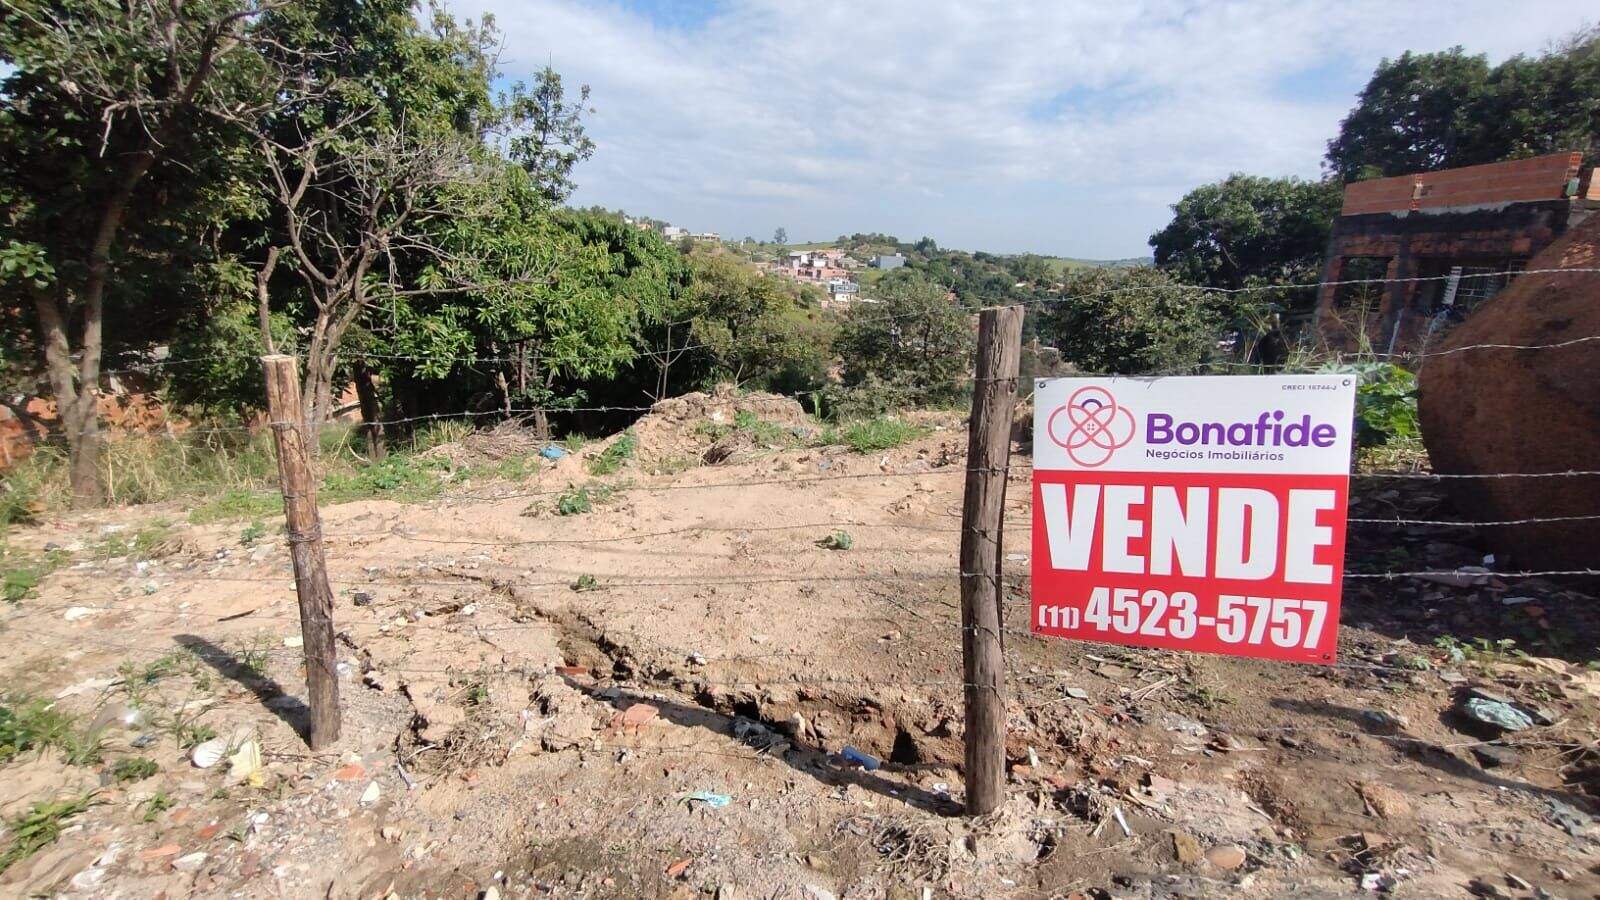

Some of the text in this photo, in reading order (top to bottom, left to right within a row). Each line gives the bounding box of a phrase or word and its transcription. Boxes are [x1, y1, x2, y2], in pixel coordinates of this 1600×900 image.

[1146, 410, 1337, 448] Bonafide
[1145, 449, 1285, 461] Negócios Imobiliários
[1040, 483, 1337, 585] VENDE
[1038, 587, 1328, 649] (11) 4523-5757
